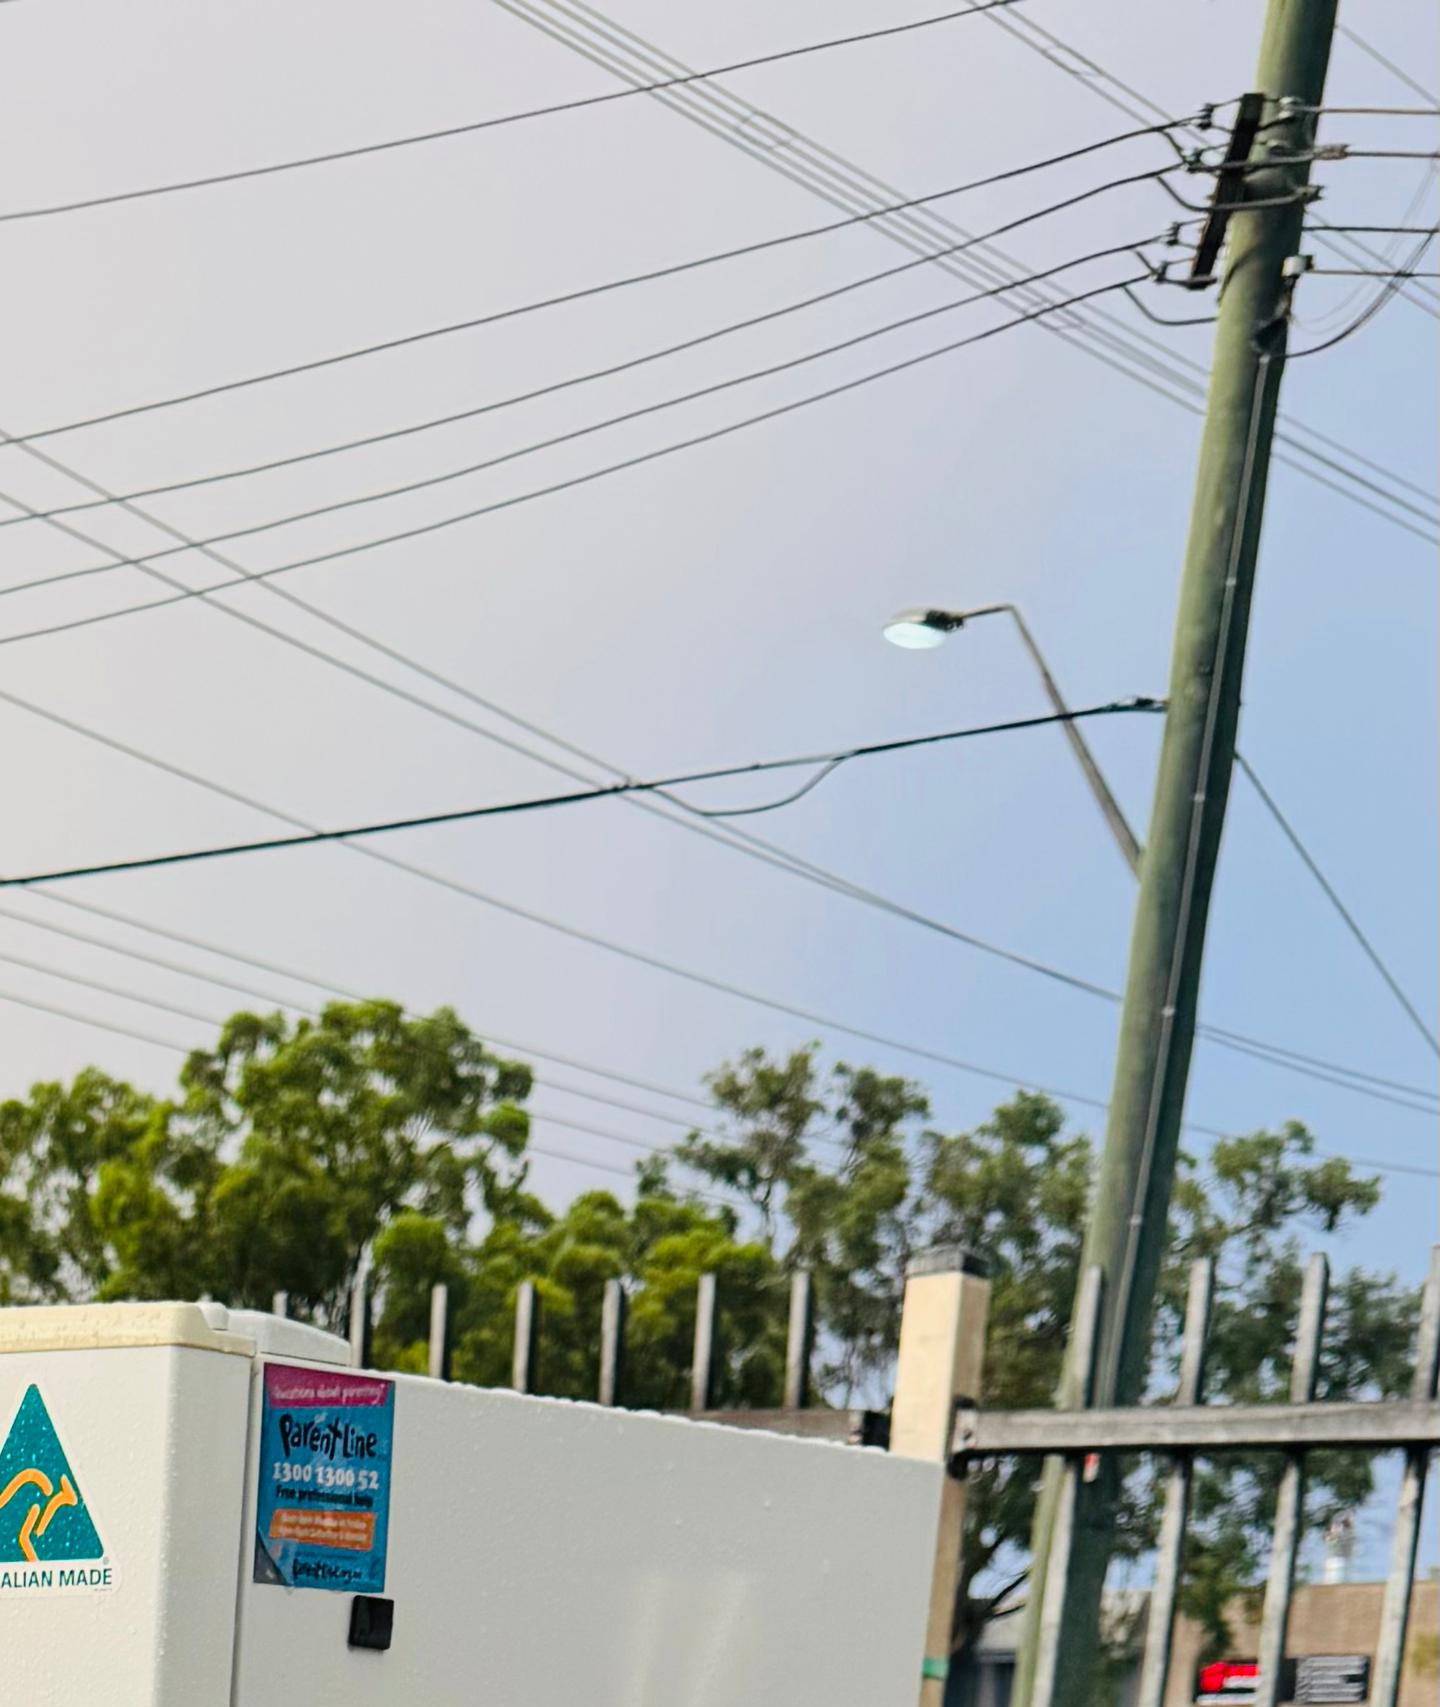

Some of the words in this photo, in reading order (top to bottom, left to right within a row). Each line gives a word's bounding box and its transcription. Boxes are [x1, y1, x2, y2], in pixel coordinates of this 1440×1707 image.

[272, 1461, 313, 1482] 1300
[315, 1465, 355, 1487] 1300
[357, 1470, 380, 1491] 52
[58, 1567, 113, 1587] MADE
